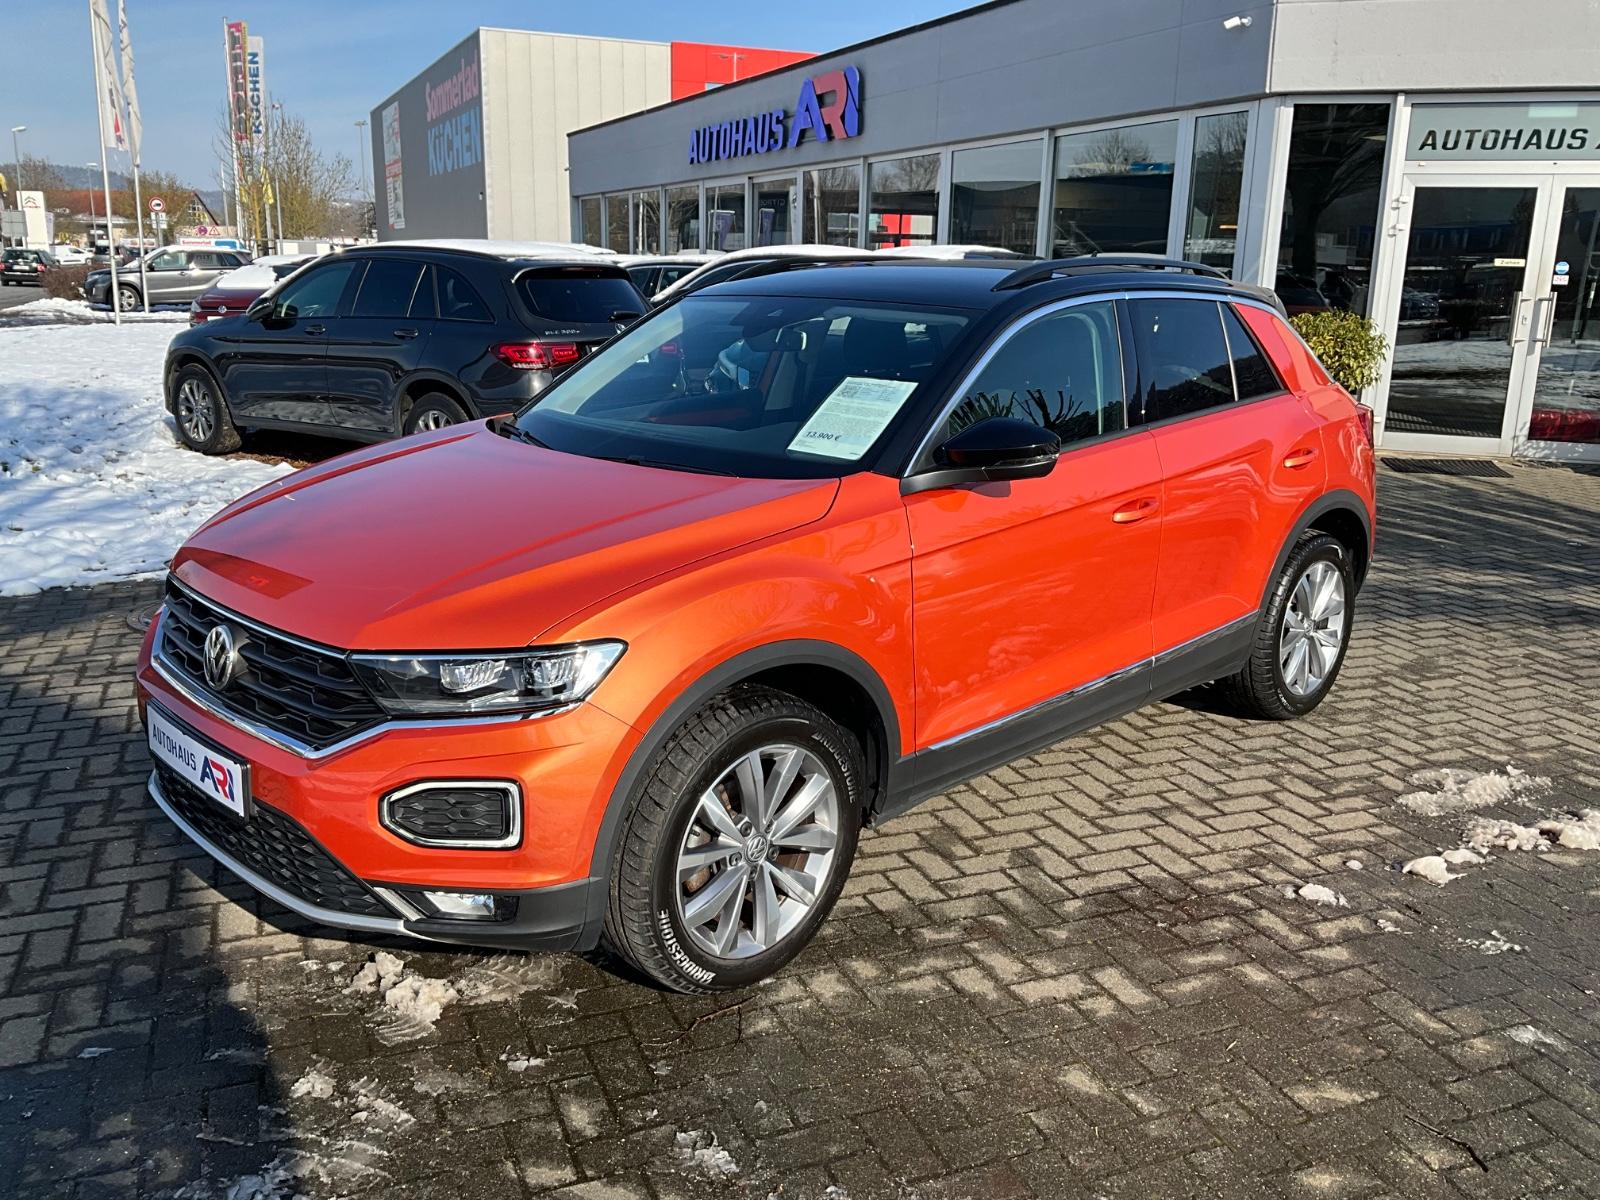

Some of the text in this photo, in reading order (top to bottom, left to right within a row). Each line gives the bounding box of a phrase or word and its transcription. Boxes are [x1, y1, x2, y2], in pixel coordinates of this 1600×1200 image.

[425, 51, 479, 122] Sommerlad
[689, 65, 862, 164] AUTOHAUS ARI
[427, 105, 482, 177] KÜCHEN
[1418, 128, 1589, 151] AUTOHAUS
[152, 723, 197, 771] AUTOHAUS
[199, 755, 236, 803] ARI
[657, 907, 717, 984] BRIDGESTONE
